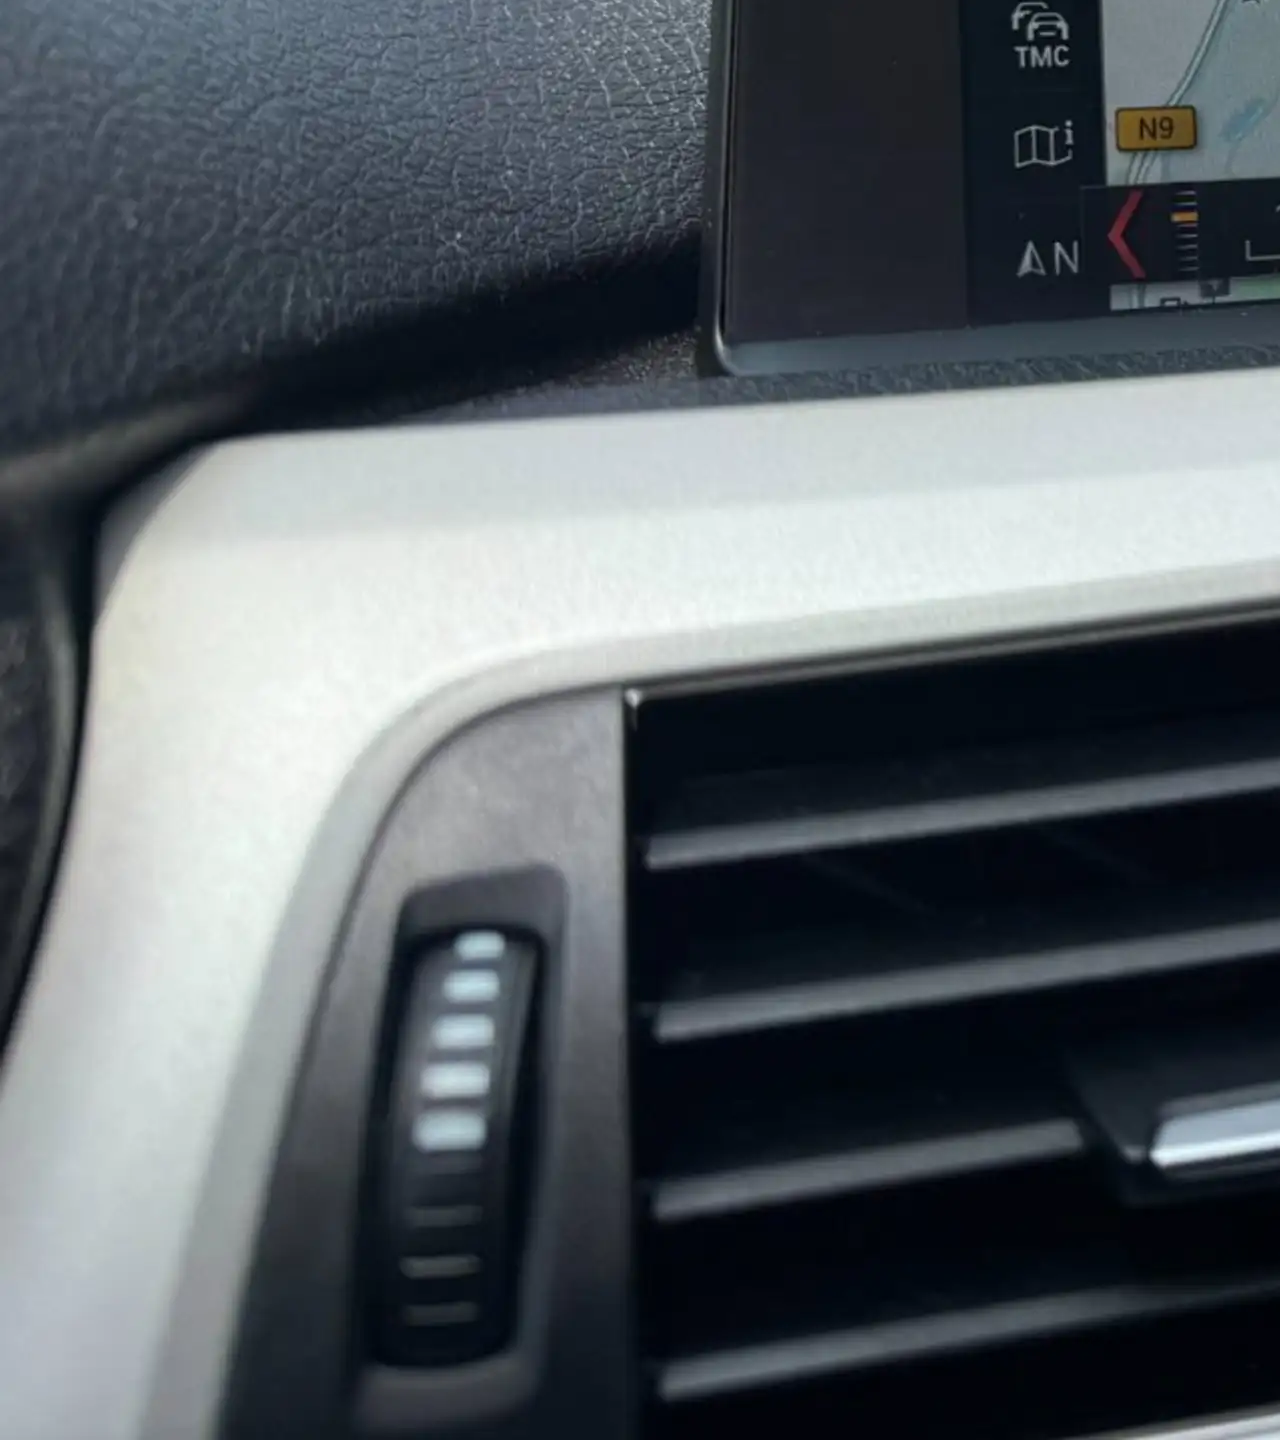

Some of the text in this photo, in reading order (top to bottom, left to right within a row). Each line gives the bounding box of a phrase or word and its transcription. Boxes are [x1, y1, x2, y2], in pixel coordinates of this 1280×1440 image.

[1014, 45, 1070, 69] TMC
[1138, 115, 1175, 140] N9
[1054, 240, 1080, 275] N
